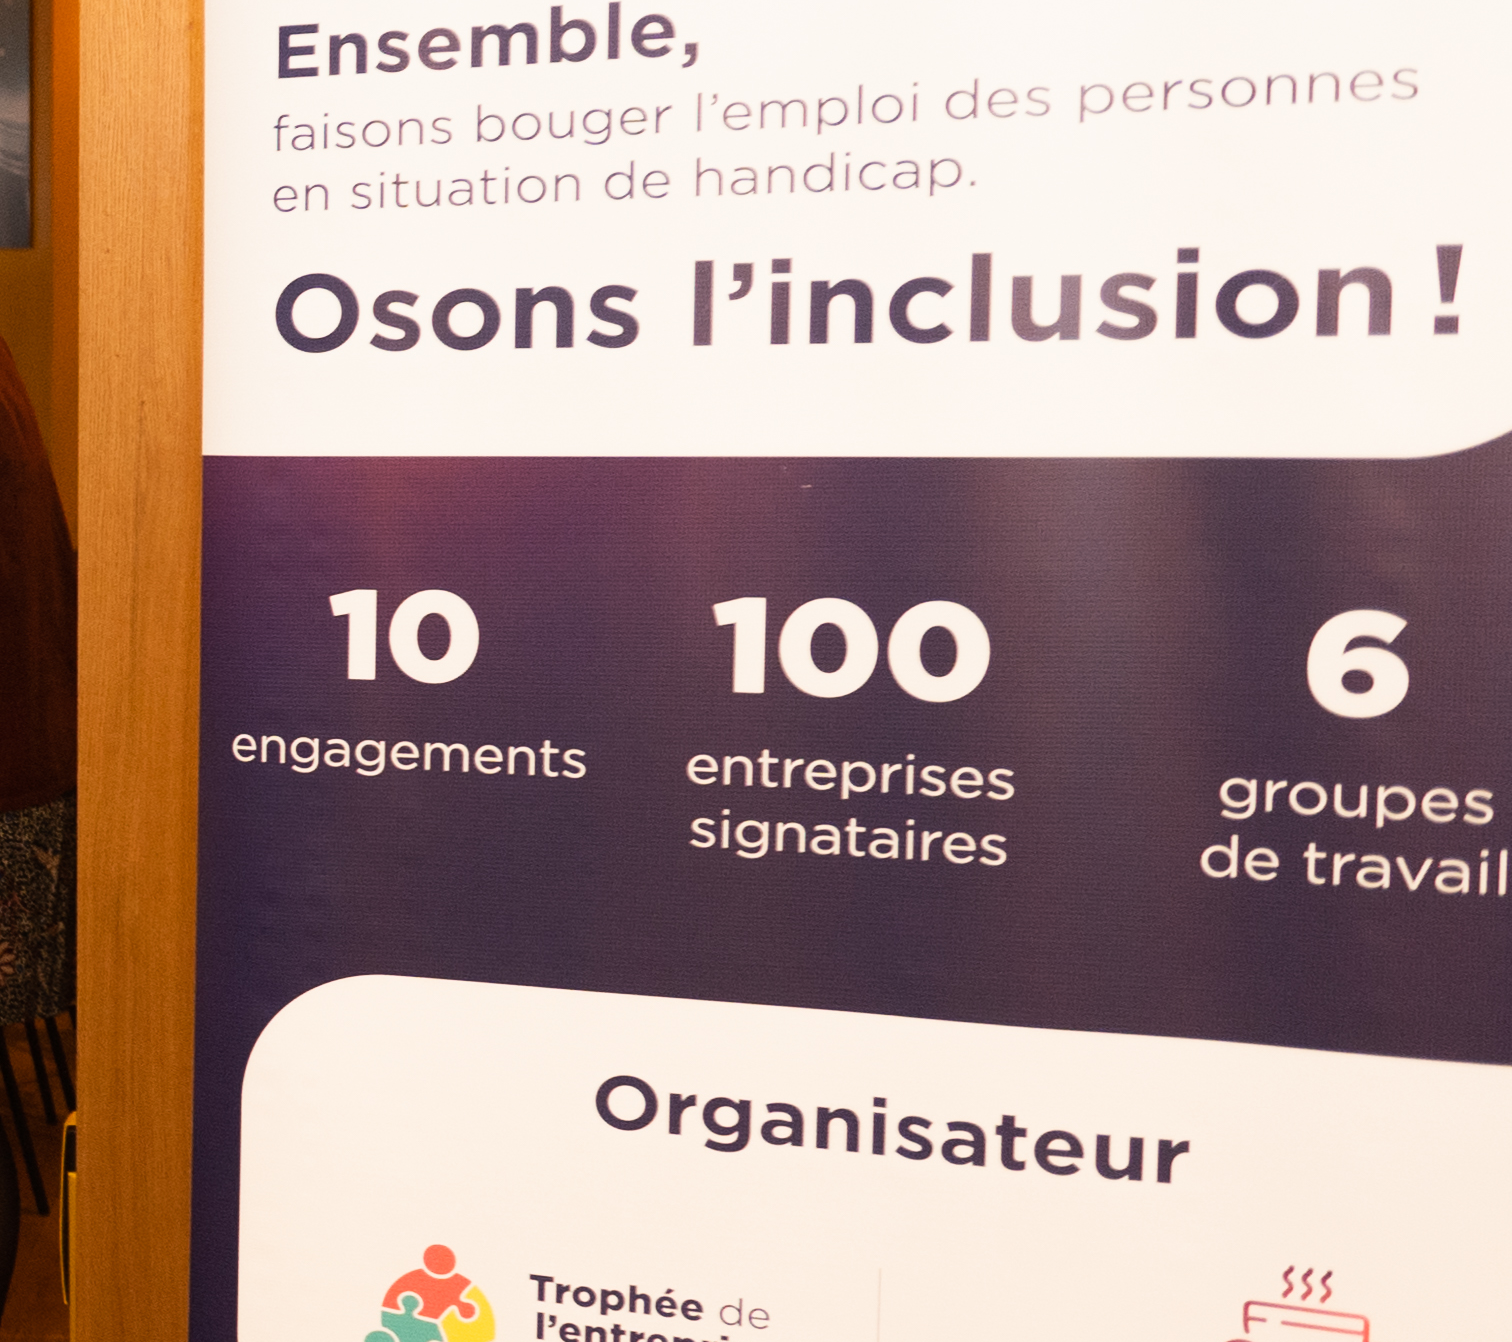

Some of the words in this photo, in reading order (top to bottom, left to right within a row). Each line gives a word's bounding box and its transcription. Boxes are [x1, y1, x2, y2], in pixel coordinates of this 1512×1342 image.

[277, 0, 701, 79] Ensemble,
[272, 109, 454, 153] faisons
[475, 100, 673, 147] bouger
[695, 81, 920, 136] l'emploi
[944, 78, 1050, 121] des
[1077, 65, 1421, 124] personnes
[272, 178, 330, 215] en
[350, 165, 581, 211] situation
[603, 157, 672, 202] de
[694, 149, 978, 199] handicap.
[274, 272, 639, 354] Osons
[693, 247, 1393, 347] l'inclusion
[1433, 244, 1463, 335] !
[329, 589, 480, 684] 10
[712, 596, 991, 703] 100
[1306, 609, 1410, 719] 6
[231, 726, 588, 780] engagements
[685, 746, 1016, 802] entreprises
[1218, 772, 1495, 829] groupes
[690, 808, 1007, 866] signataires
[1200, 834, 1280, 881] de
[1303, 842, 1508, 896] travail
[595, 1074, 1190, 1184] Organisateur
[528, 1272, 706, 1323] Trophée
[717, 1296, 771, 1330] de
